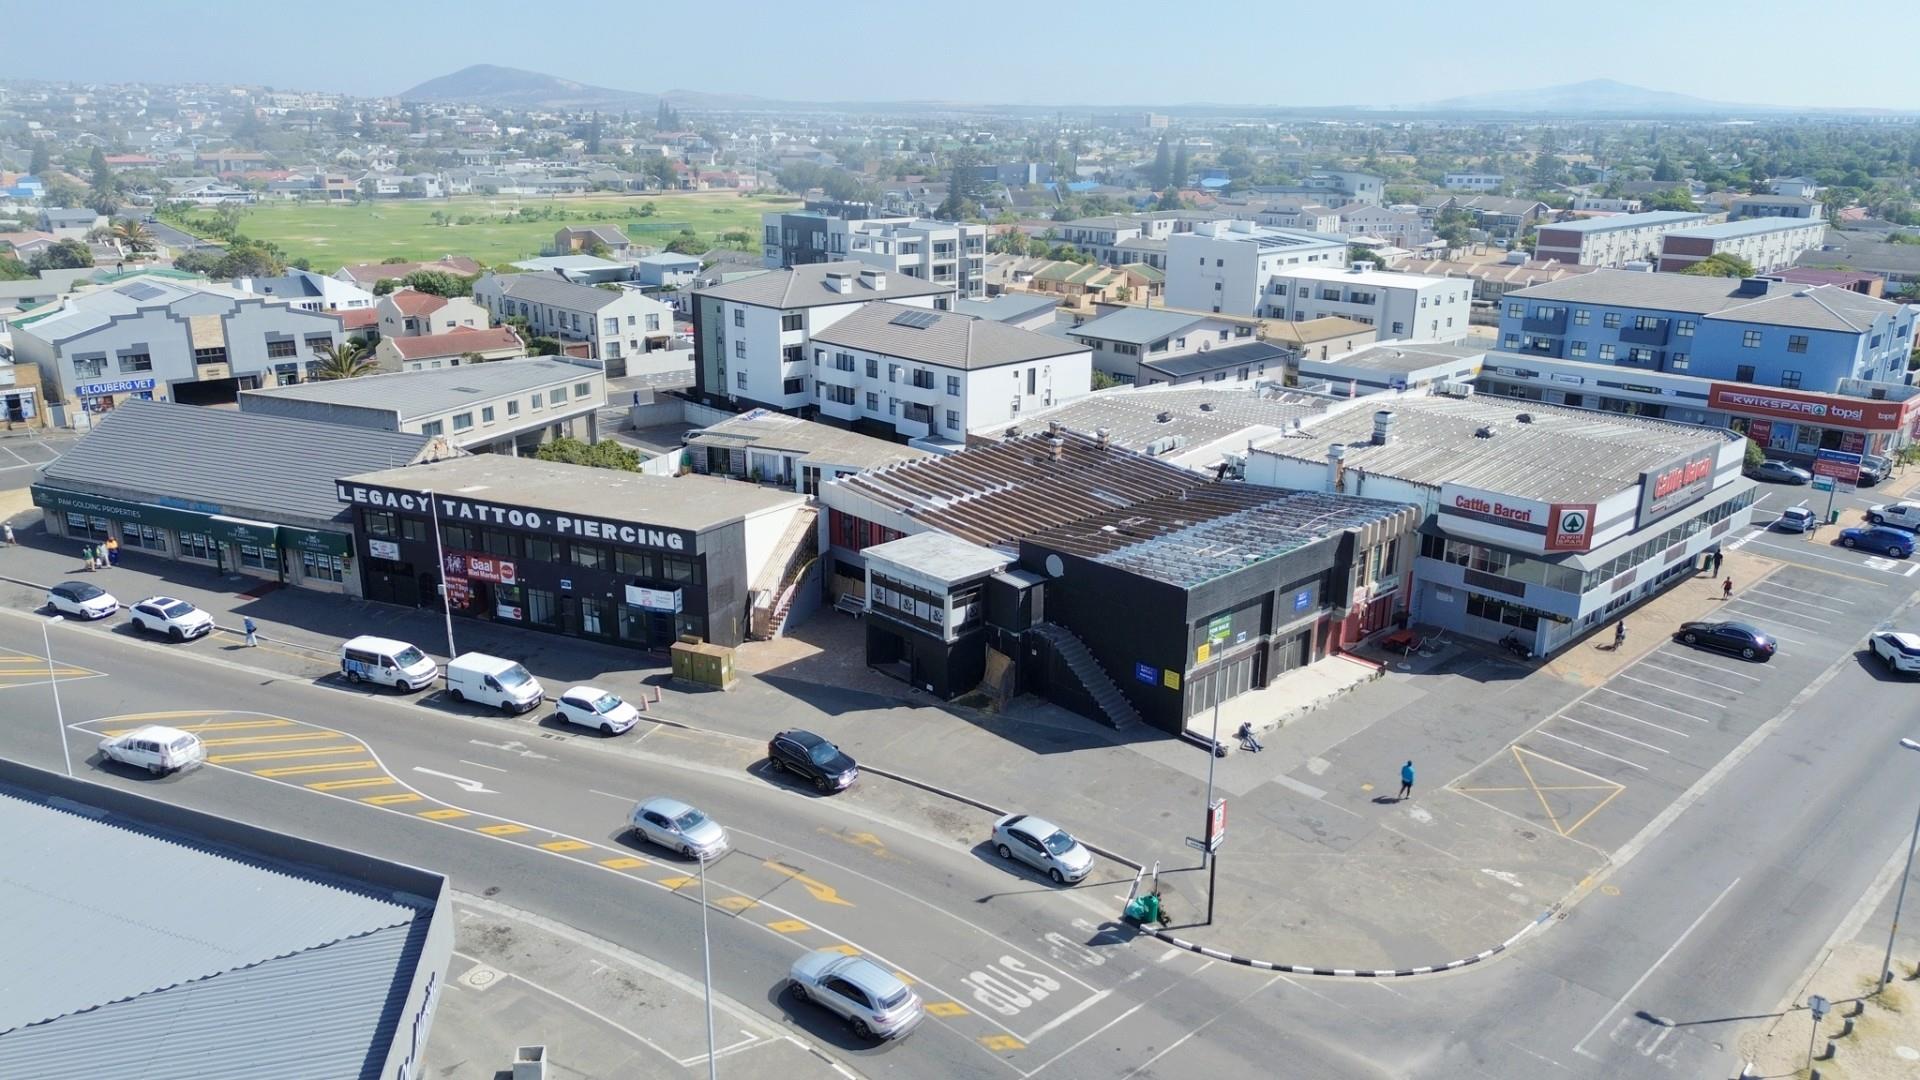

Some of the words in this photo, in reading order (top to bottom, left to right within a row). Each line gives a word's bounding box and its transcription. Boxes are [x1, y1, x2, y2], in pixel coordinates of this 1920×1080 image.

[81, 382, 132, 395] BLOUBERG
[134, 379, 152, 392] VET
[1733, 395, 1812, 413] KWIKSPAR
[1655, 467, 1683, 498] Cattle
[1682, 457, 1712, 486] Baron
[72, 500, 101, 511] GOLDING
[102, 503, 142, 519] PROPERTIES
[338, 485, 430, 512] LEGACY
[443, 500, 541, 529] TATTOO
[557, 517, 684, 550] PIERCING
[1455, 495, 1490, 513] Cattle
[1494, 502, 1530, 521] Baron
[471, 557, 493, 572] Gaal
[480, 571, 500, 580] Market
[960, 955, 1061, 1016] STOP
